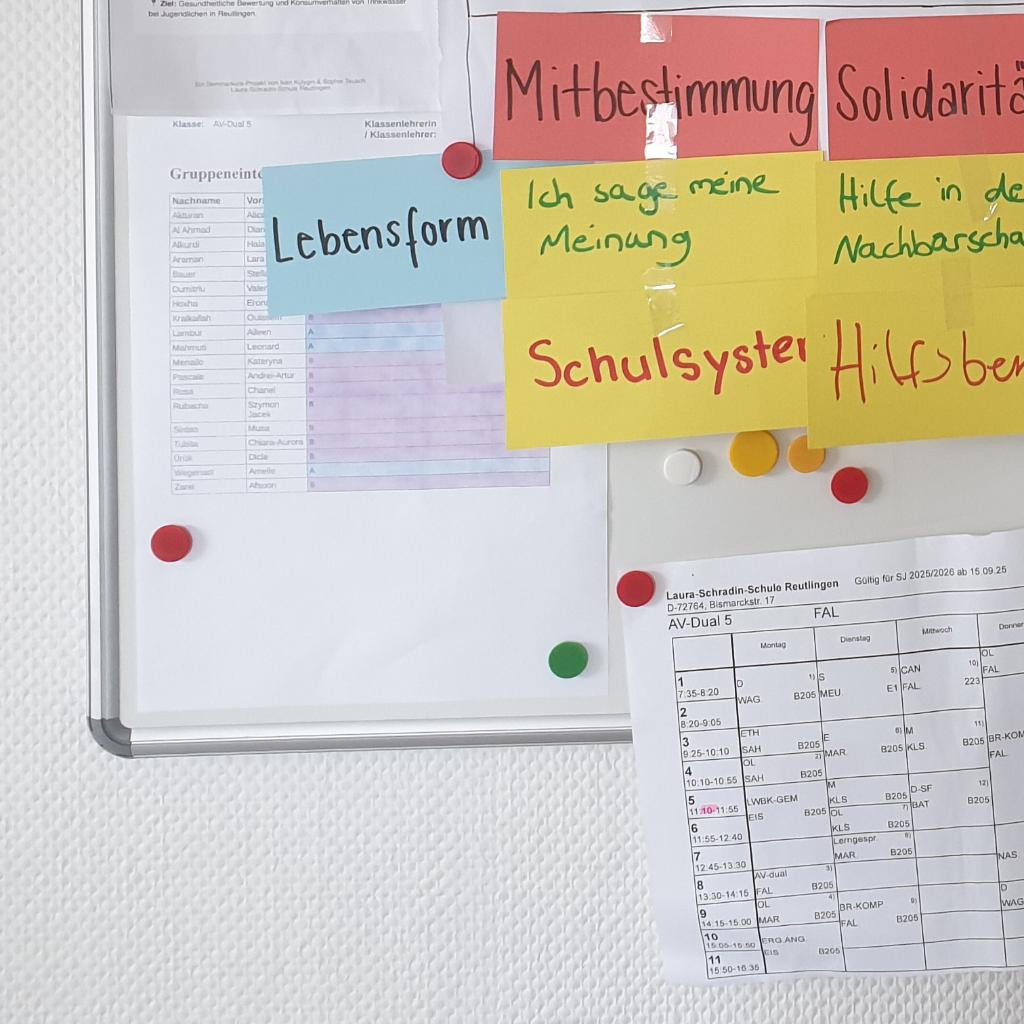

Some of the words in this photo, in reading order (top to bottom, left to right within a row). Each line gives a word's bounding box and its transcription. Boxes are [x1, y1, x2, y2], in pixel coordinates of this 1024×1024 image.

[505, 57, 814, 147] Mitbestimmung
[365, 120, 437, 128] Klassenlehrerin
[172, 197, 221, 205] Nachname
[528, 178, 572, 211] Ich
[593, 180, 677, 216] sage
[689, 170, 780, 195] meine
[839, 172, 921, 215] Hilfe
[936, 177, 961, 202] in
[272, 206, 489, 269] Lebensform
[540, 224, 691, 268] Meinung
[855, 574, 880, 586] Gültig
[883, 573, 894, 583] für
[897, 571, 907, 582] SJ
[909, 567, 955, 580] 2025/2026
[957, 566, 968, 576] ab
[970, 564, 1007, 576] 15.09.25
[666, 582, 782, 600] Laura-Schradin-Schule
[785, 579, 839, 592] Reutlingen
[667, 601, 707, 613] D-72764,
[709, 597, 763, 609] Bismarckstr.
[765, 595, 775, 605] 17
[668, 615, 720, 630] AV-Dual
[724, 615, 732, 626] 5
[814, 607, 839, 619] FAL
[760, 641, 786, 650] Montag
[840, 635, 871, 644] Dienstag
[922, 626, 953, 635] Mittwoch
